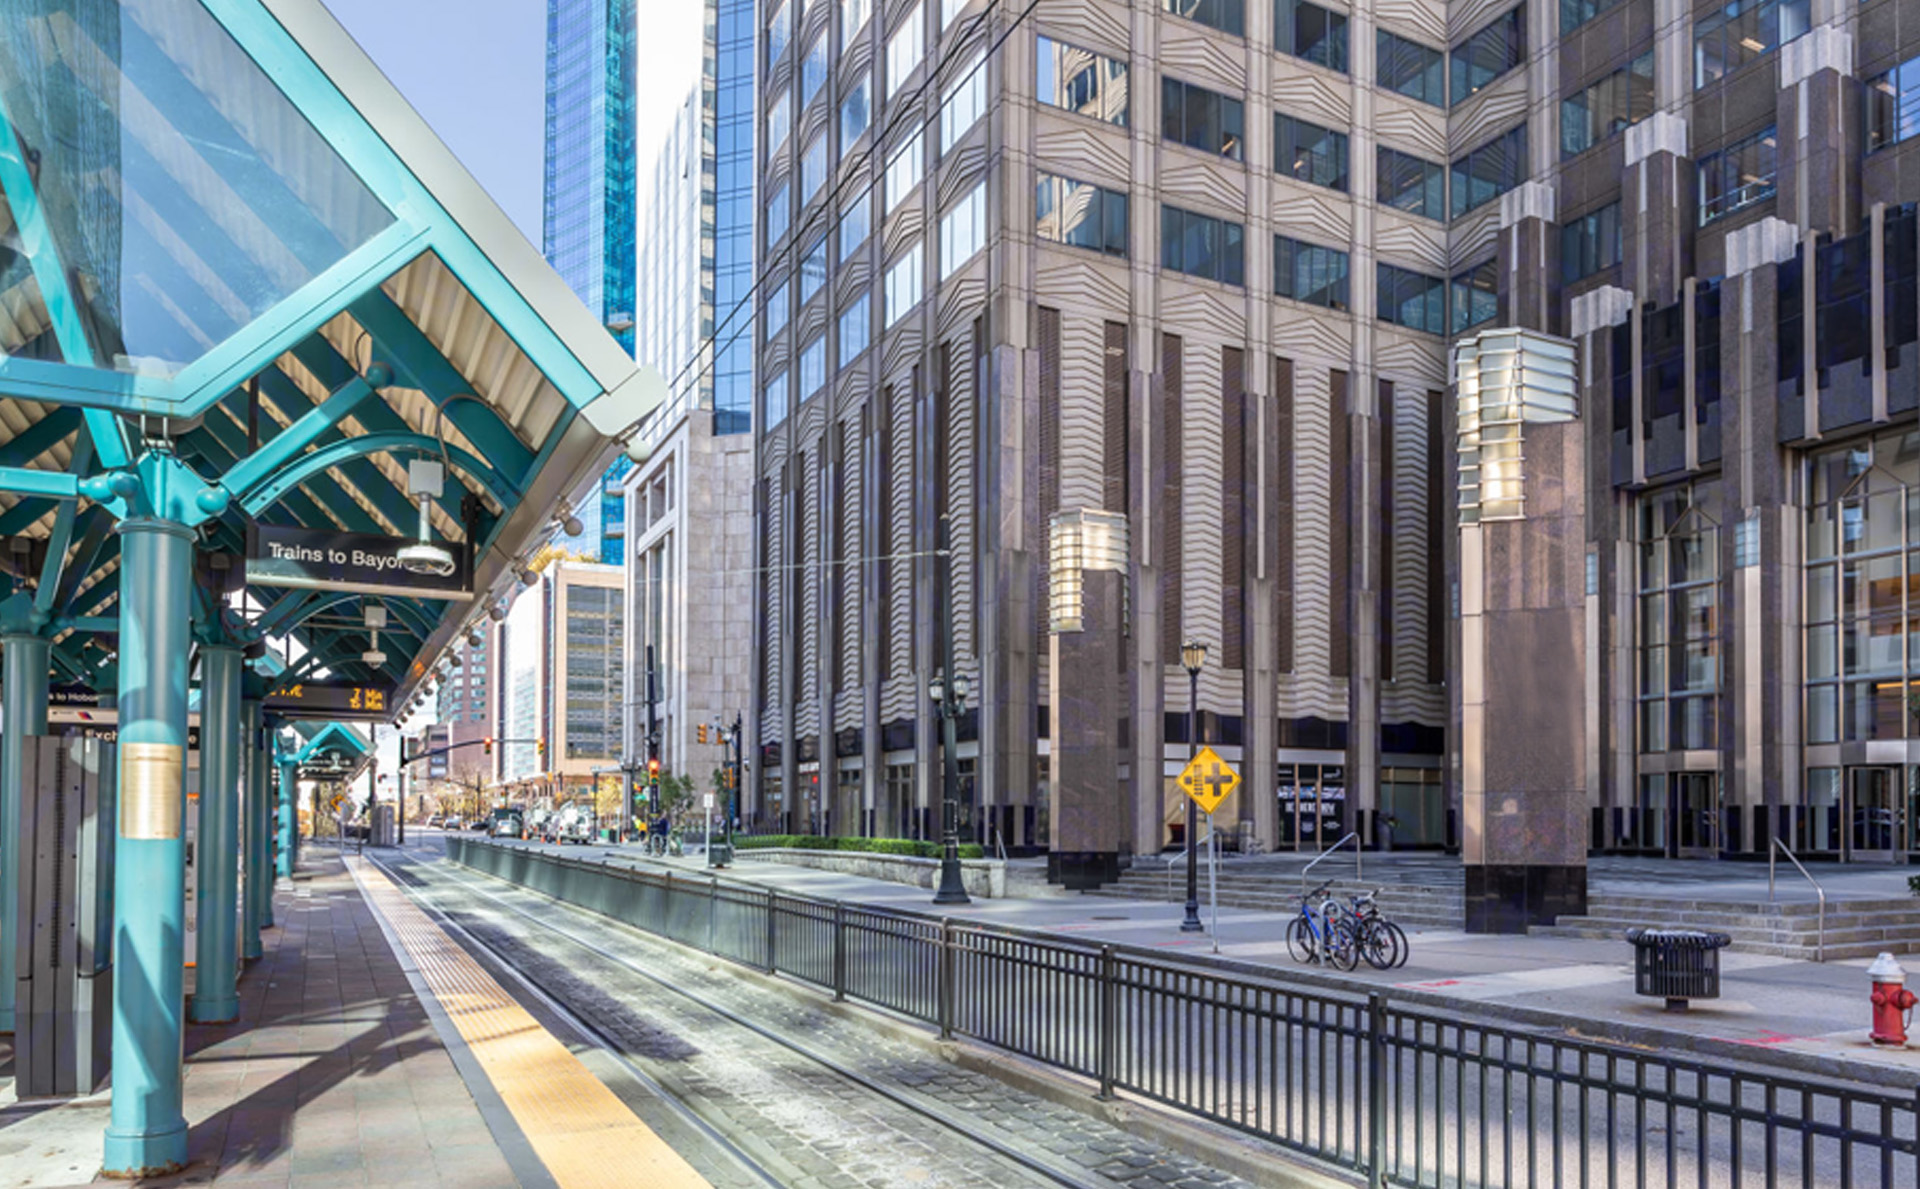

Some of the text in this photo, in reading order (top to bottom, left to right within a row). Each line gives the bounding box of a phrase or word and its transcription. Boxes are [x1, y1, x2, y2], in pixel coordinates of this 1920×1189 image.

[268, 542, 402, 571] Trains to Bayo
